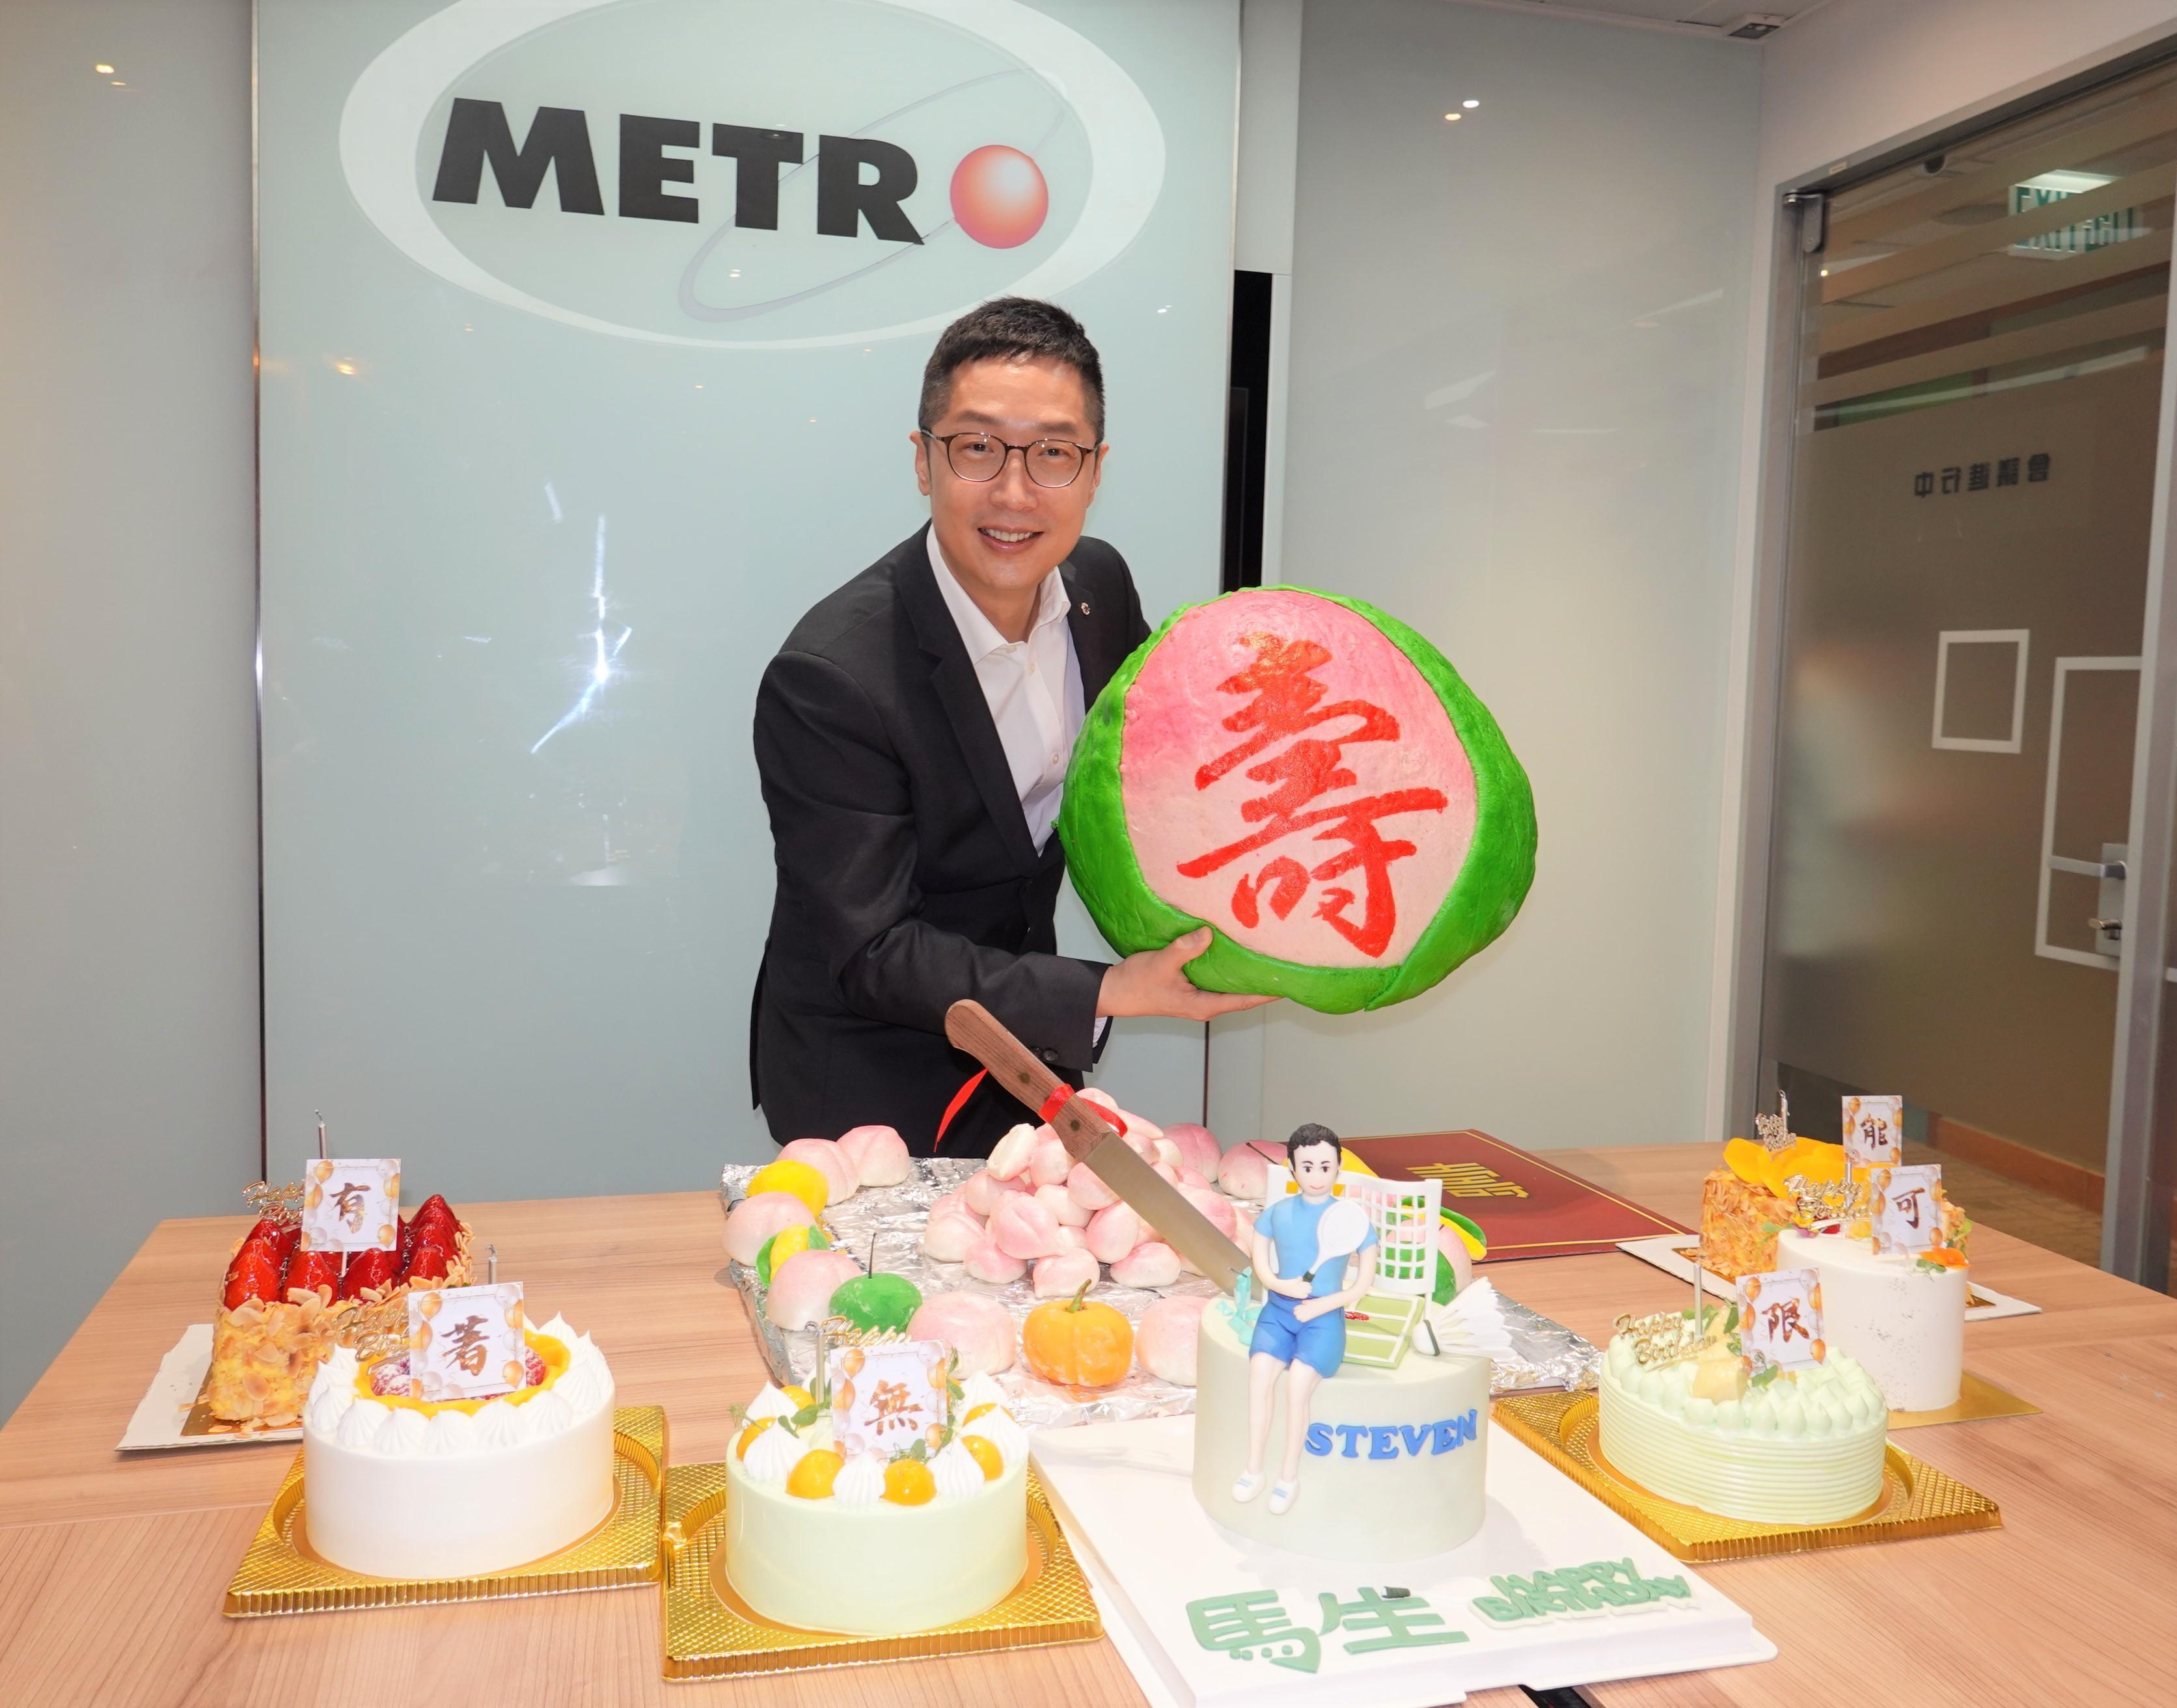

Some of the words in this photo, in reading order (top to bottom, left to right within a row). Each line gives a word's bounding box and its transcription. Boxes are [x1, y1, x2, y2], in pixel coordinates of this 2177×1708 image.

[1177, 630, 1448, 958] 壽
[1861, 1114, 1887, 1150] 能
[330, 1182, 372, 1233] 有
[1890, 1186, 1925, 1228] 可
[1613, 1310, 1684, 1355] Happy
[1762, 1297, 1810, 1344] 限
[864, 1379, 924, 1435] 無
[1304, 1408, 1478, 1459] STEVEN
[1472, 1574, 1691, 1621] BIRTHDAY
[1489, 1556, 1641, 1596] HAPPY
[1185, 1586, 1470, 1674] 馬生
